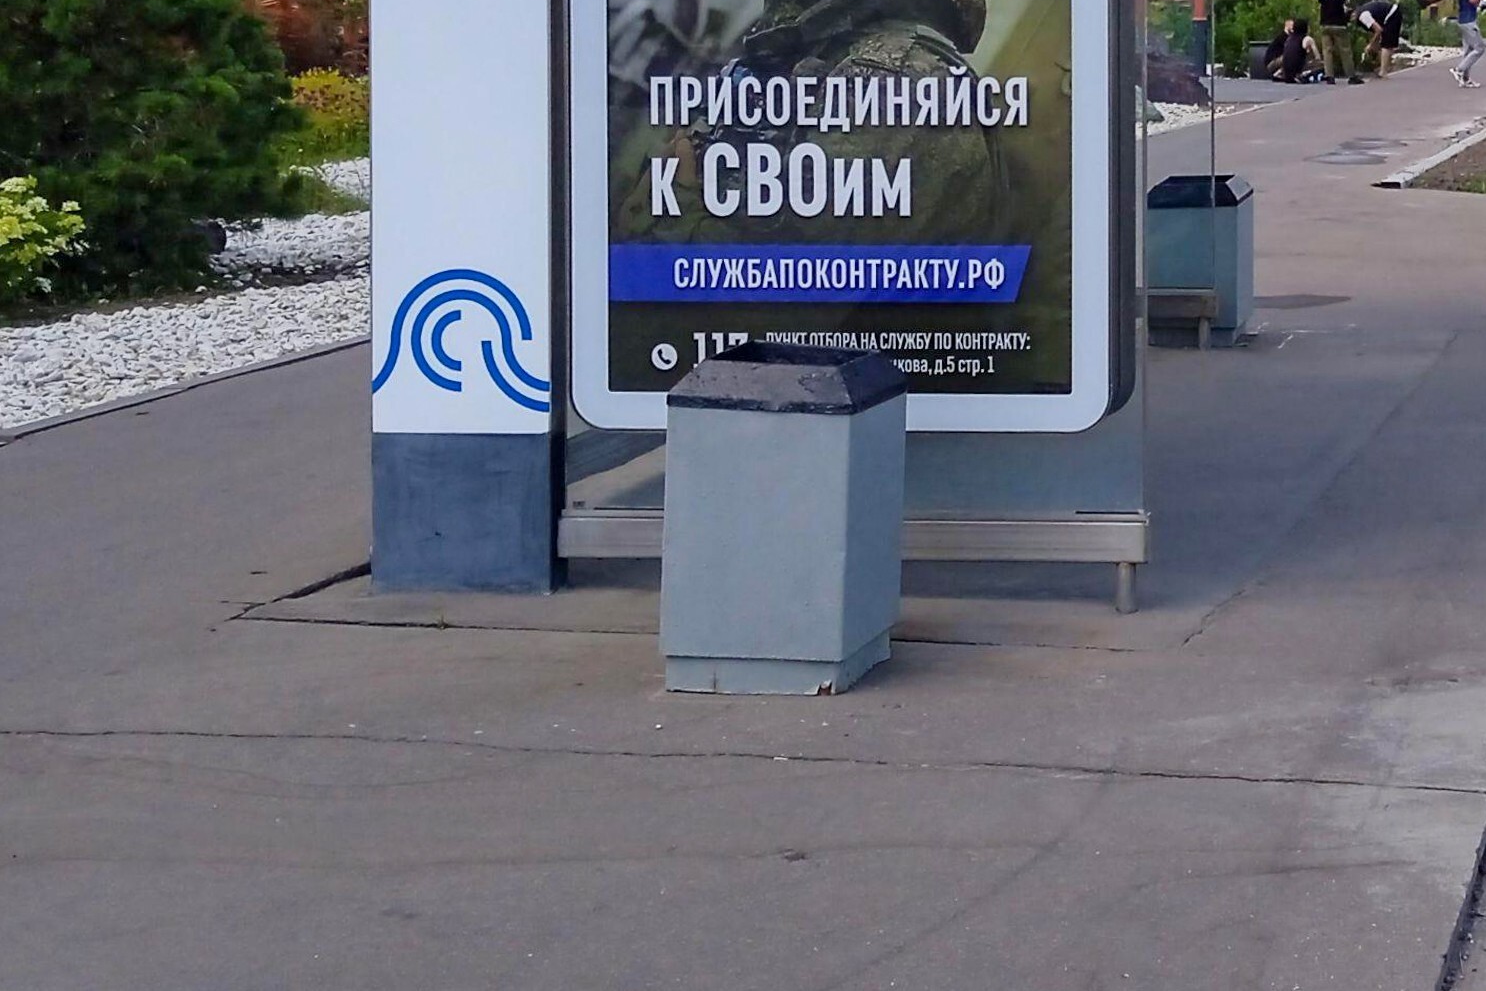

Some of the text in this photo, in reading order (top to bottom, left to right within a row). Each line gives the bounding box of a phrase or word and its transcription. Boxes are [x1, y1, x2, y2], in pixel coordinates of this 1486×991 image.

[650, 66, 1028, 133] ПРИСОЕДИНЯЙСЯ
[674, 257, 1005, 290] СЛУЖБАПОКОНТРАКТУ.РФ
[809, 332, 858, 349] ОТБОРА
[860, 332, 878, 350] НА
[879, 332, 932, 350] СЛУЖБУ
[934, 332, 952, 350] ПО
[955, 332, 1031, 350] КОНТРАКТУ:
[934, 356, 956, 375] д.5
[958, 359, 985, 376] стр.
[987, 356, 995, 373] 1
